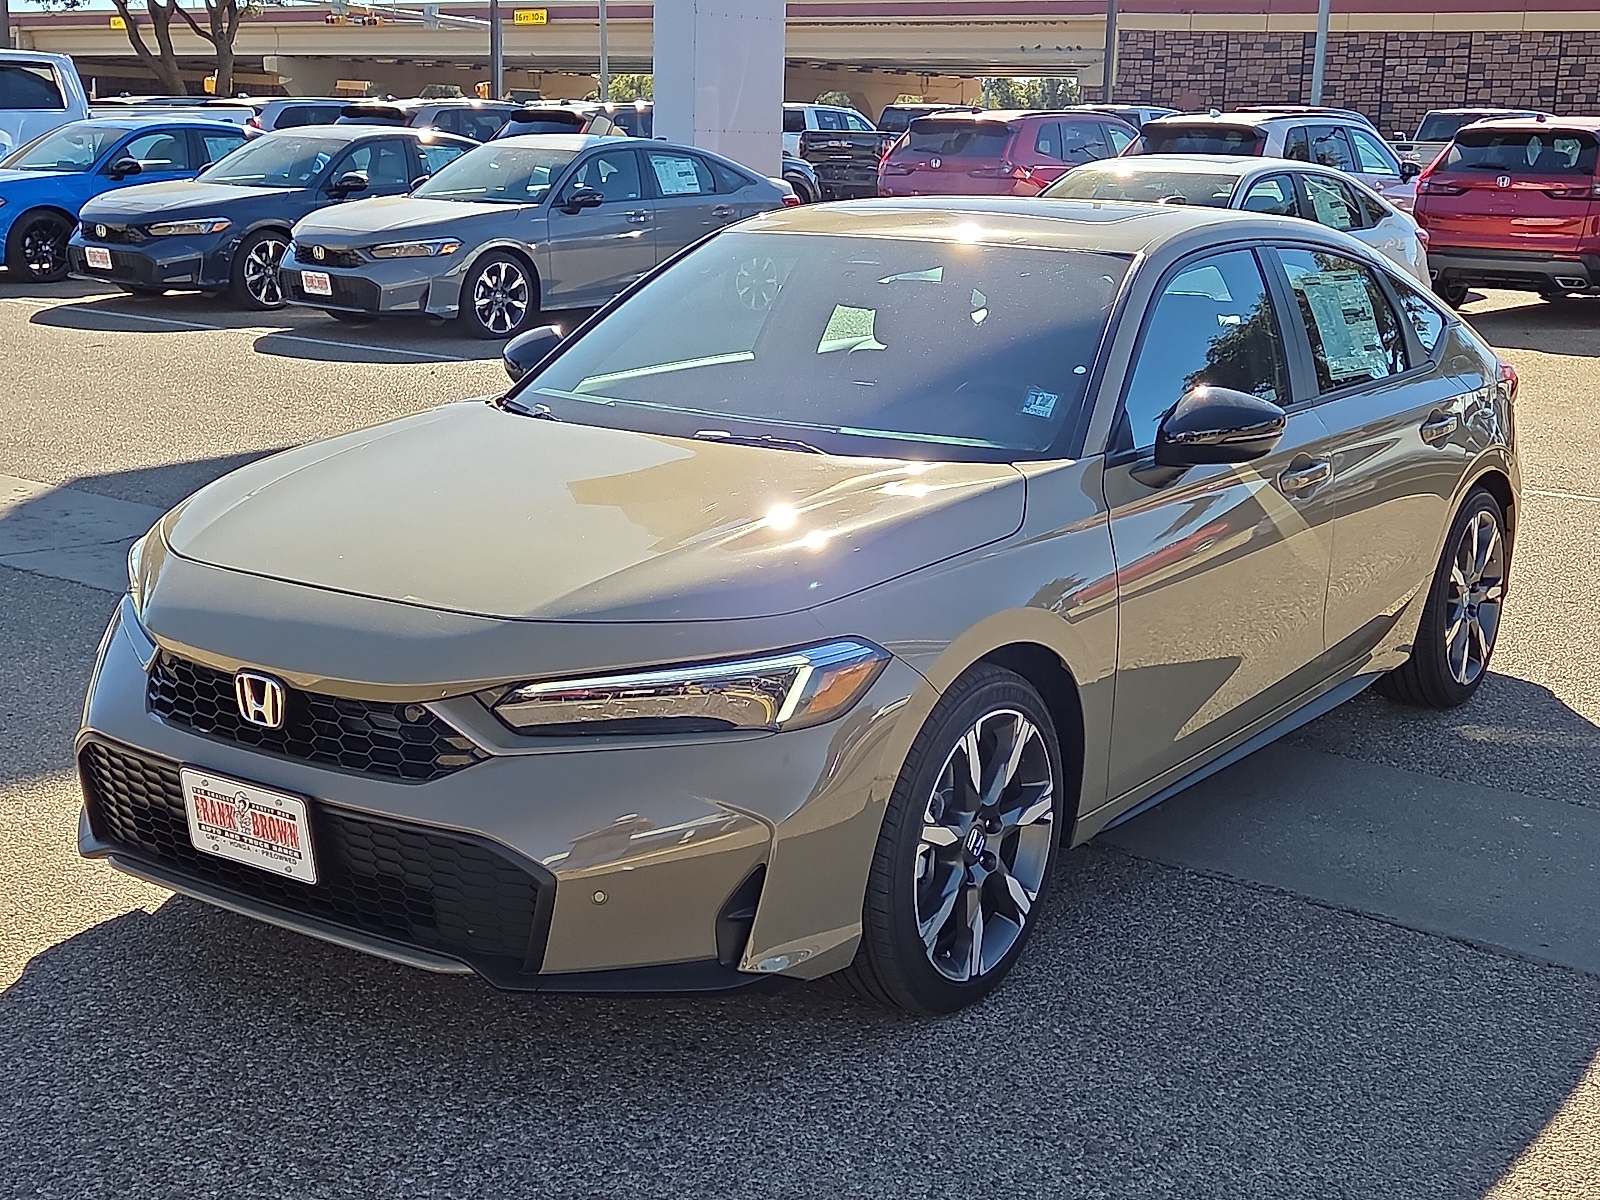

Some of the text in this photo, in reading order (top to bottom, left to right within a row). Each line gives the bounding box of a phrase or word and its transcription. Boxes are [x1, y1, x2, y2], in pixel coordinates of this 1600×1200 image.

[193, 795, 300, 851] FRANK BROWN
[200, 825, 300, 858] AUTO AND TRUCK RANCH
[205, 833, 220, 843] GMC
[229, 840, 252, 852] HONDA
